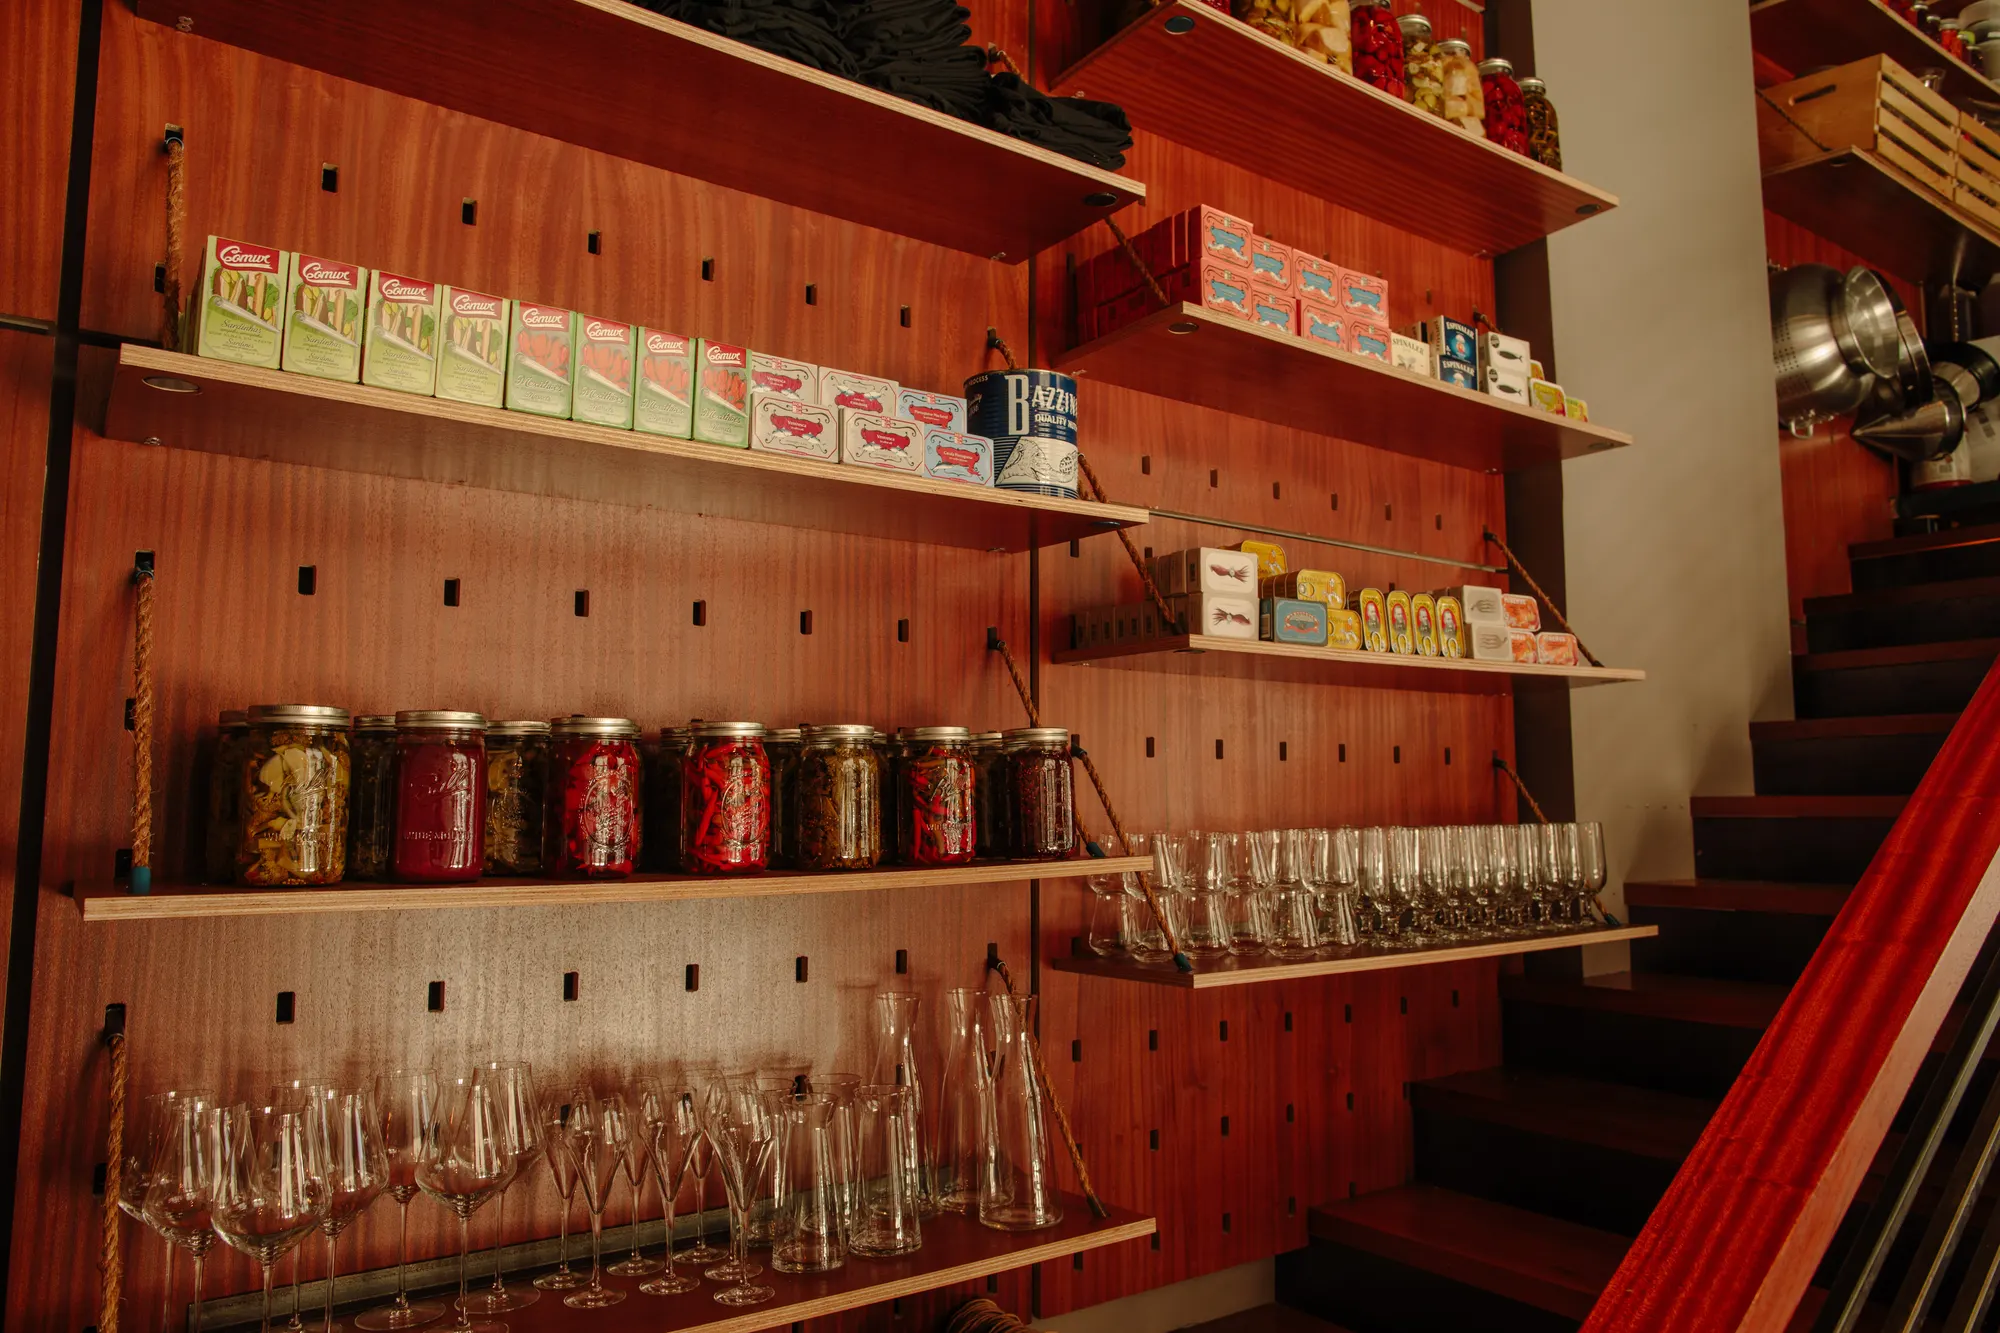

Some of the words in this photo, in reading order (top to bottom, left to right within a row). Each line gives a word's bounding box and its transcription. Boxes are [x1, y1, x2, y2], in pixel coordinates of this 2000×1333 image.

[1446, 321, 1475, 340] ESPINALER
[1392, 337, 1424, 356] SPINALER
[1442, 360, 1475, 377] ESPINALER
[1034, 413, 1067, 426] QUALITY
